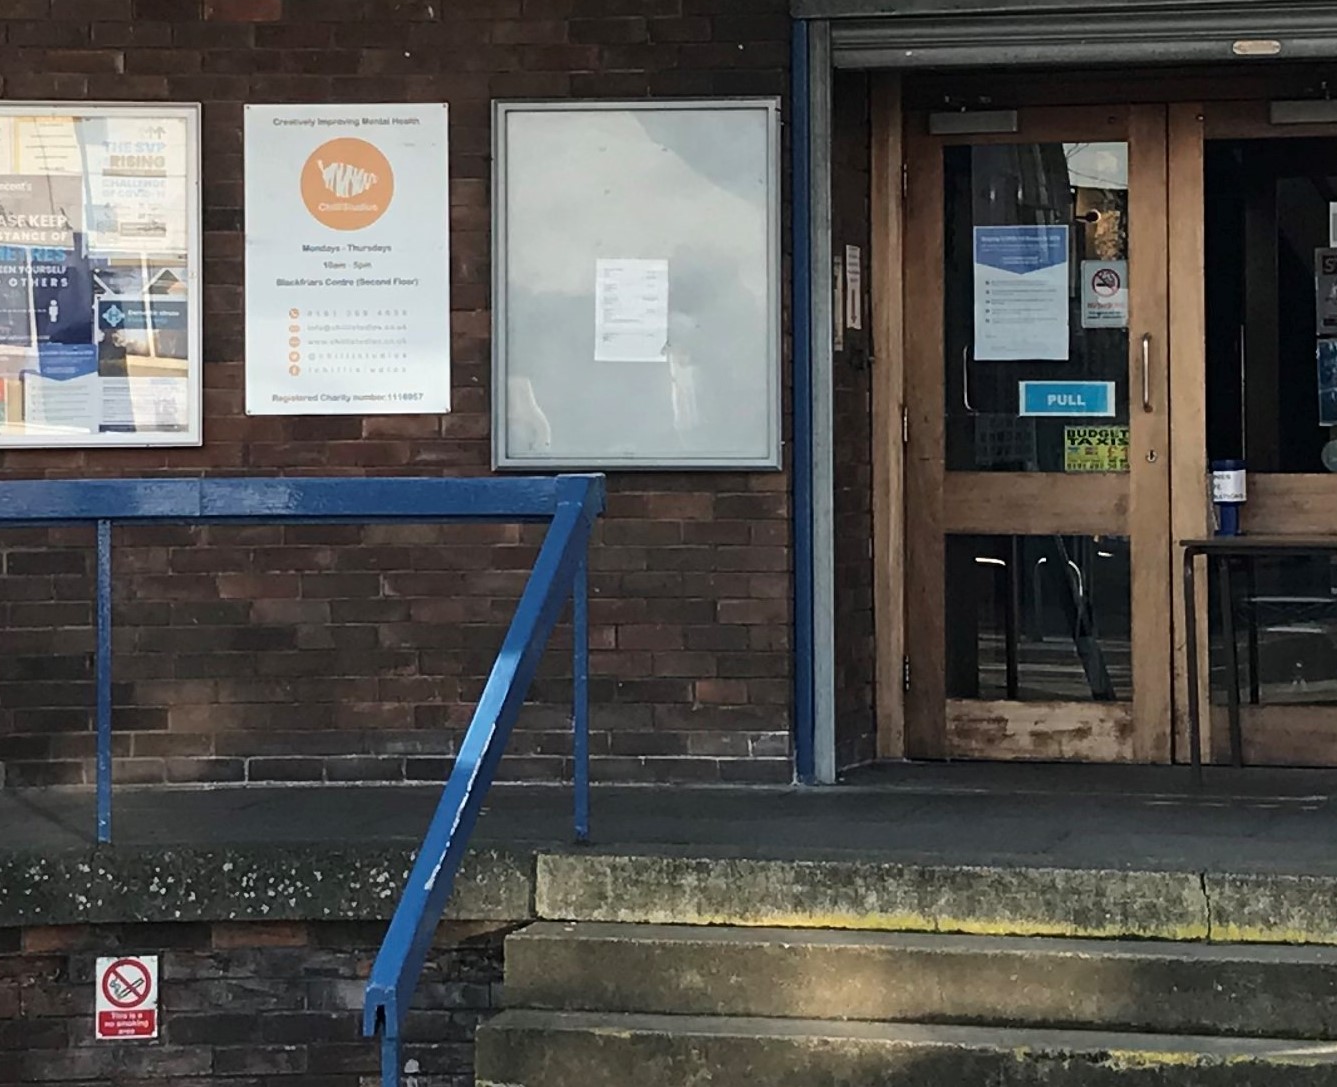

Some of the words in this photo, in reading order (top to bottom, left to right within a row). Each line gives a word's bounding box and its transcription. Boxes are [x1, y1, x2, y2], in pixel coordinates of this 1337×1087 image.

[317, 118, 360, 127] Improving
[29, 214, 67, 227] KEEP
[51, 232, 68, 241] OF
[302, 244, 340, 253] Mondays
[347, 244, 392, 253] Thursdays
[18, 265, 67, 274] YOURSELF
[8, 278, 68, 287] OTHERS
[320, 393, 351, 403] Charity
[1047, 394, 1086, 406] PULL
[1067, 429, 1130, 438] BUDGET
[1067, 437, 1130, 446] TAXIS
